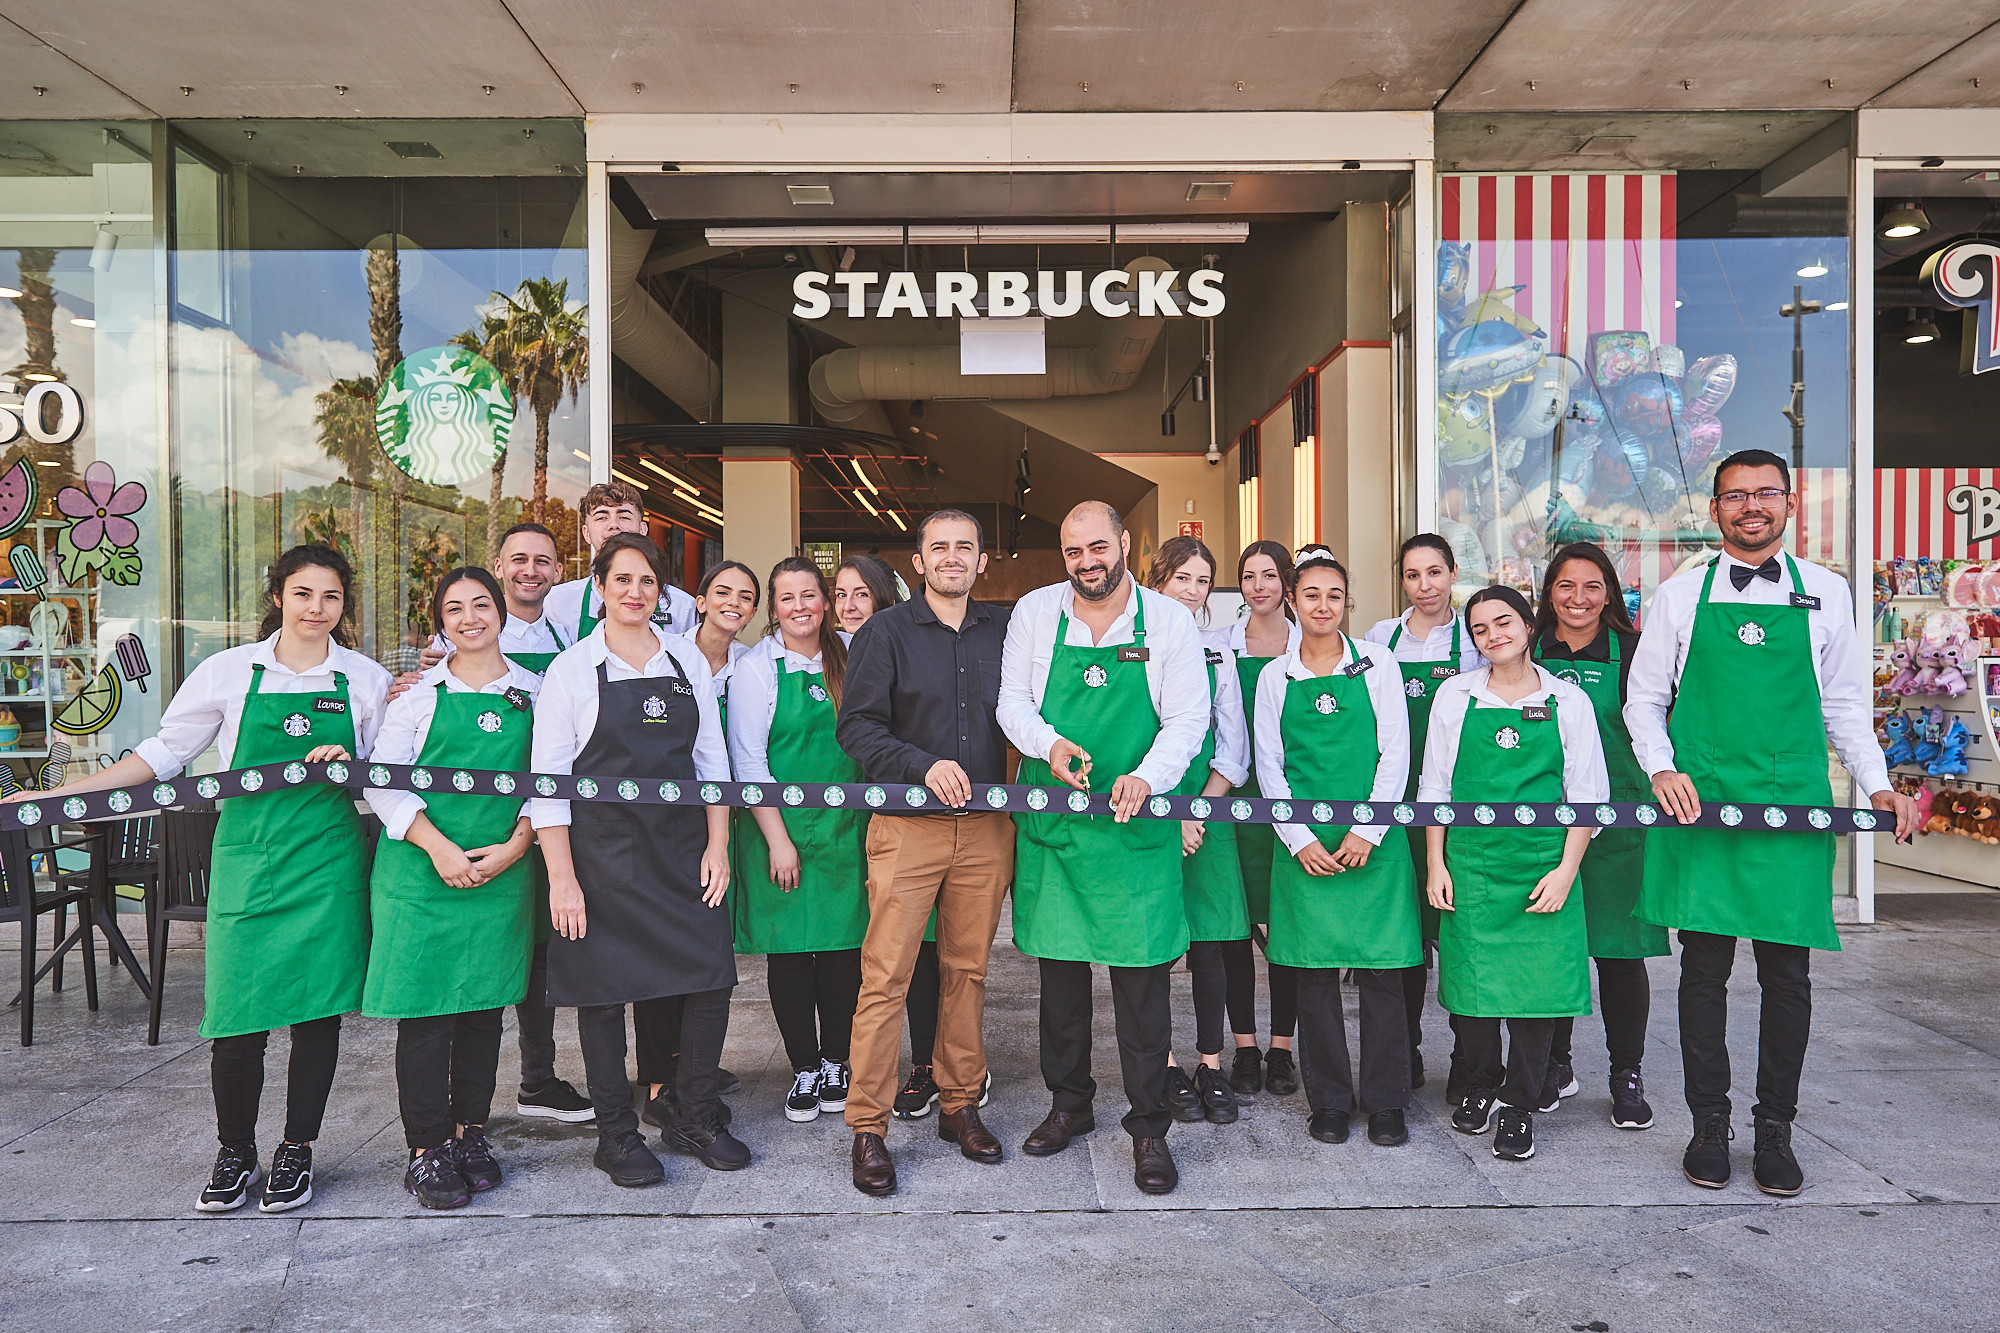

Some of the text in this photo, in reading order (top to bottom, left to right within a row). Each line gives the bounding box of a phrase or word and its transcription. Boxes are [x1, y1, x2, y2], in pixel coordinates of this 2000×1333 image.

[792, 269, 1226, 319] STARBUCKS
[1434, 666, 1456, 675] NEKO
[317, 699, 345, 712] LOURDES
